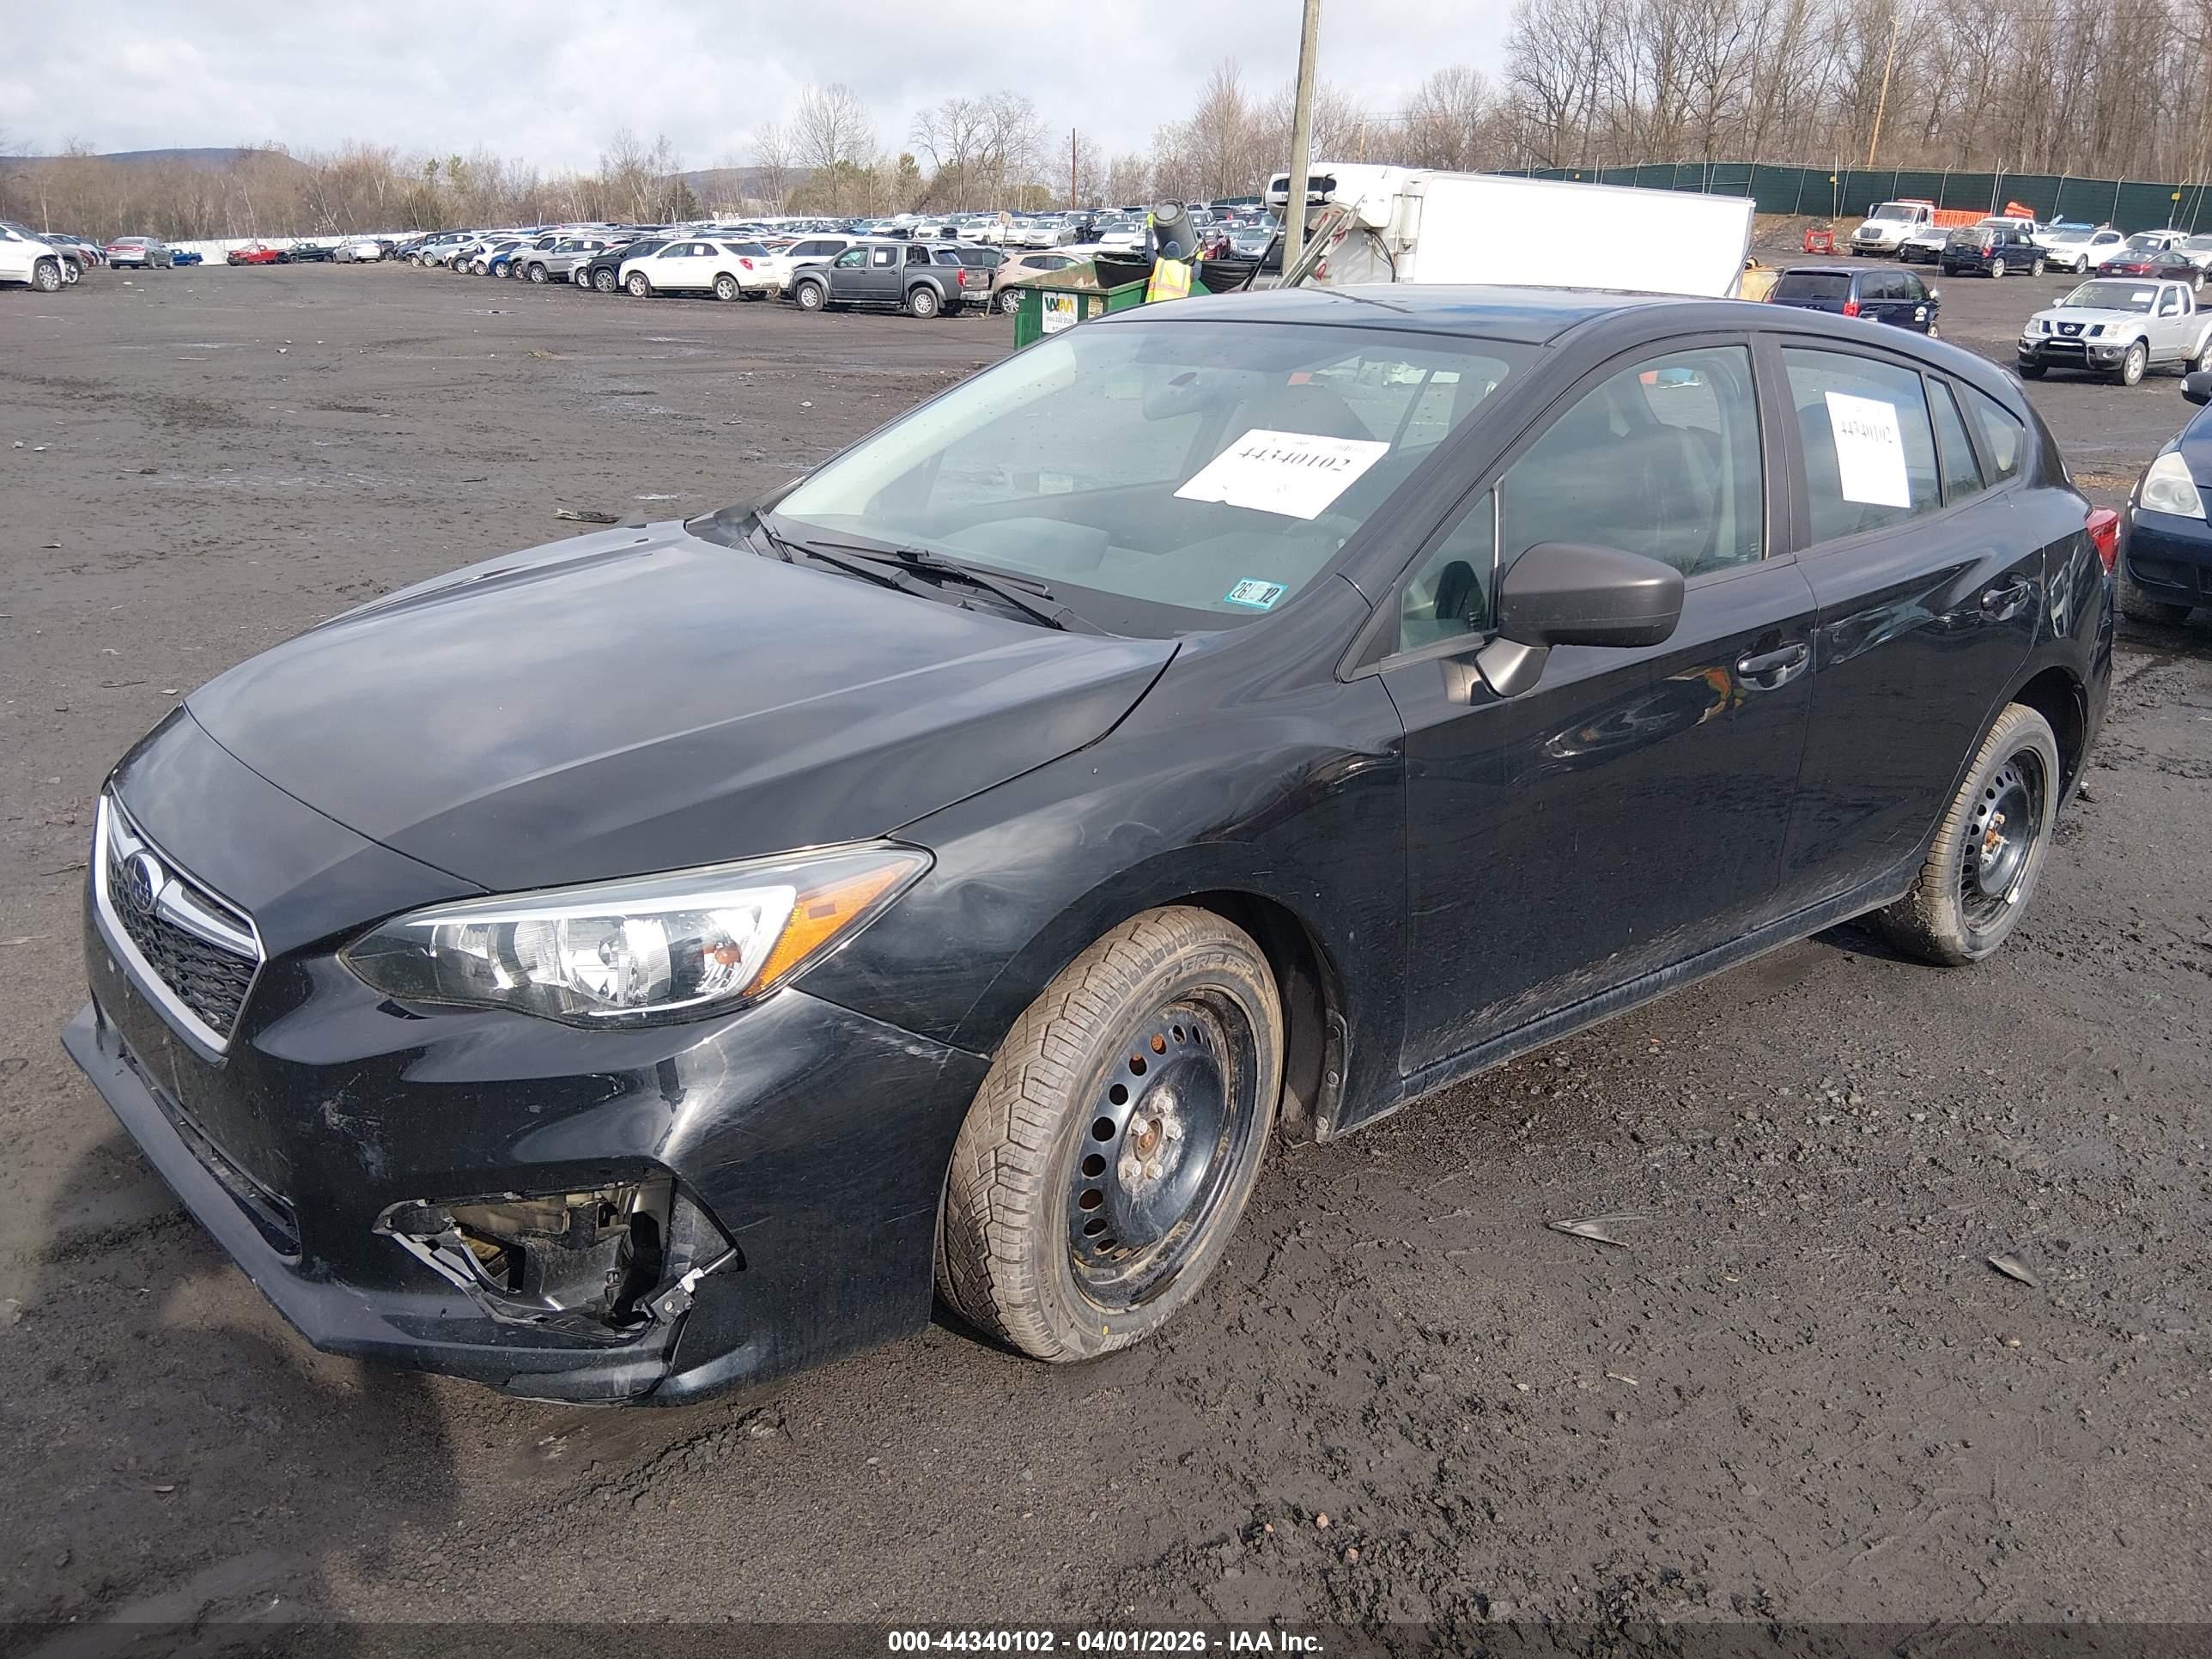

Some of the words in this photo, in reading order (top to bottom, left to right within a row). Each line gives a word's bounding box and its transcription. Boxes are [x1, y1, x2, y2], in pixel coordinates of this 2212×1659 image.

[1044, 296, 1075, 313] WM
[1238, 447, 1351, 471] 44340102
[1231, 581, 1253, 599] 26
[1257, 586, 1280, 604] 12
